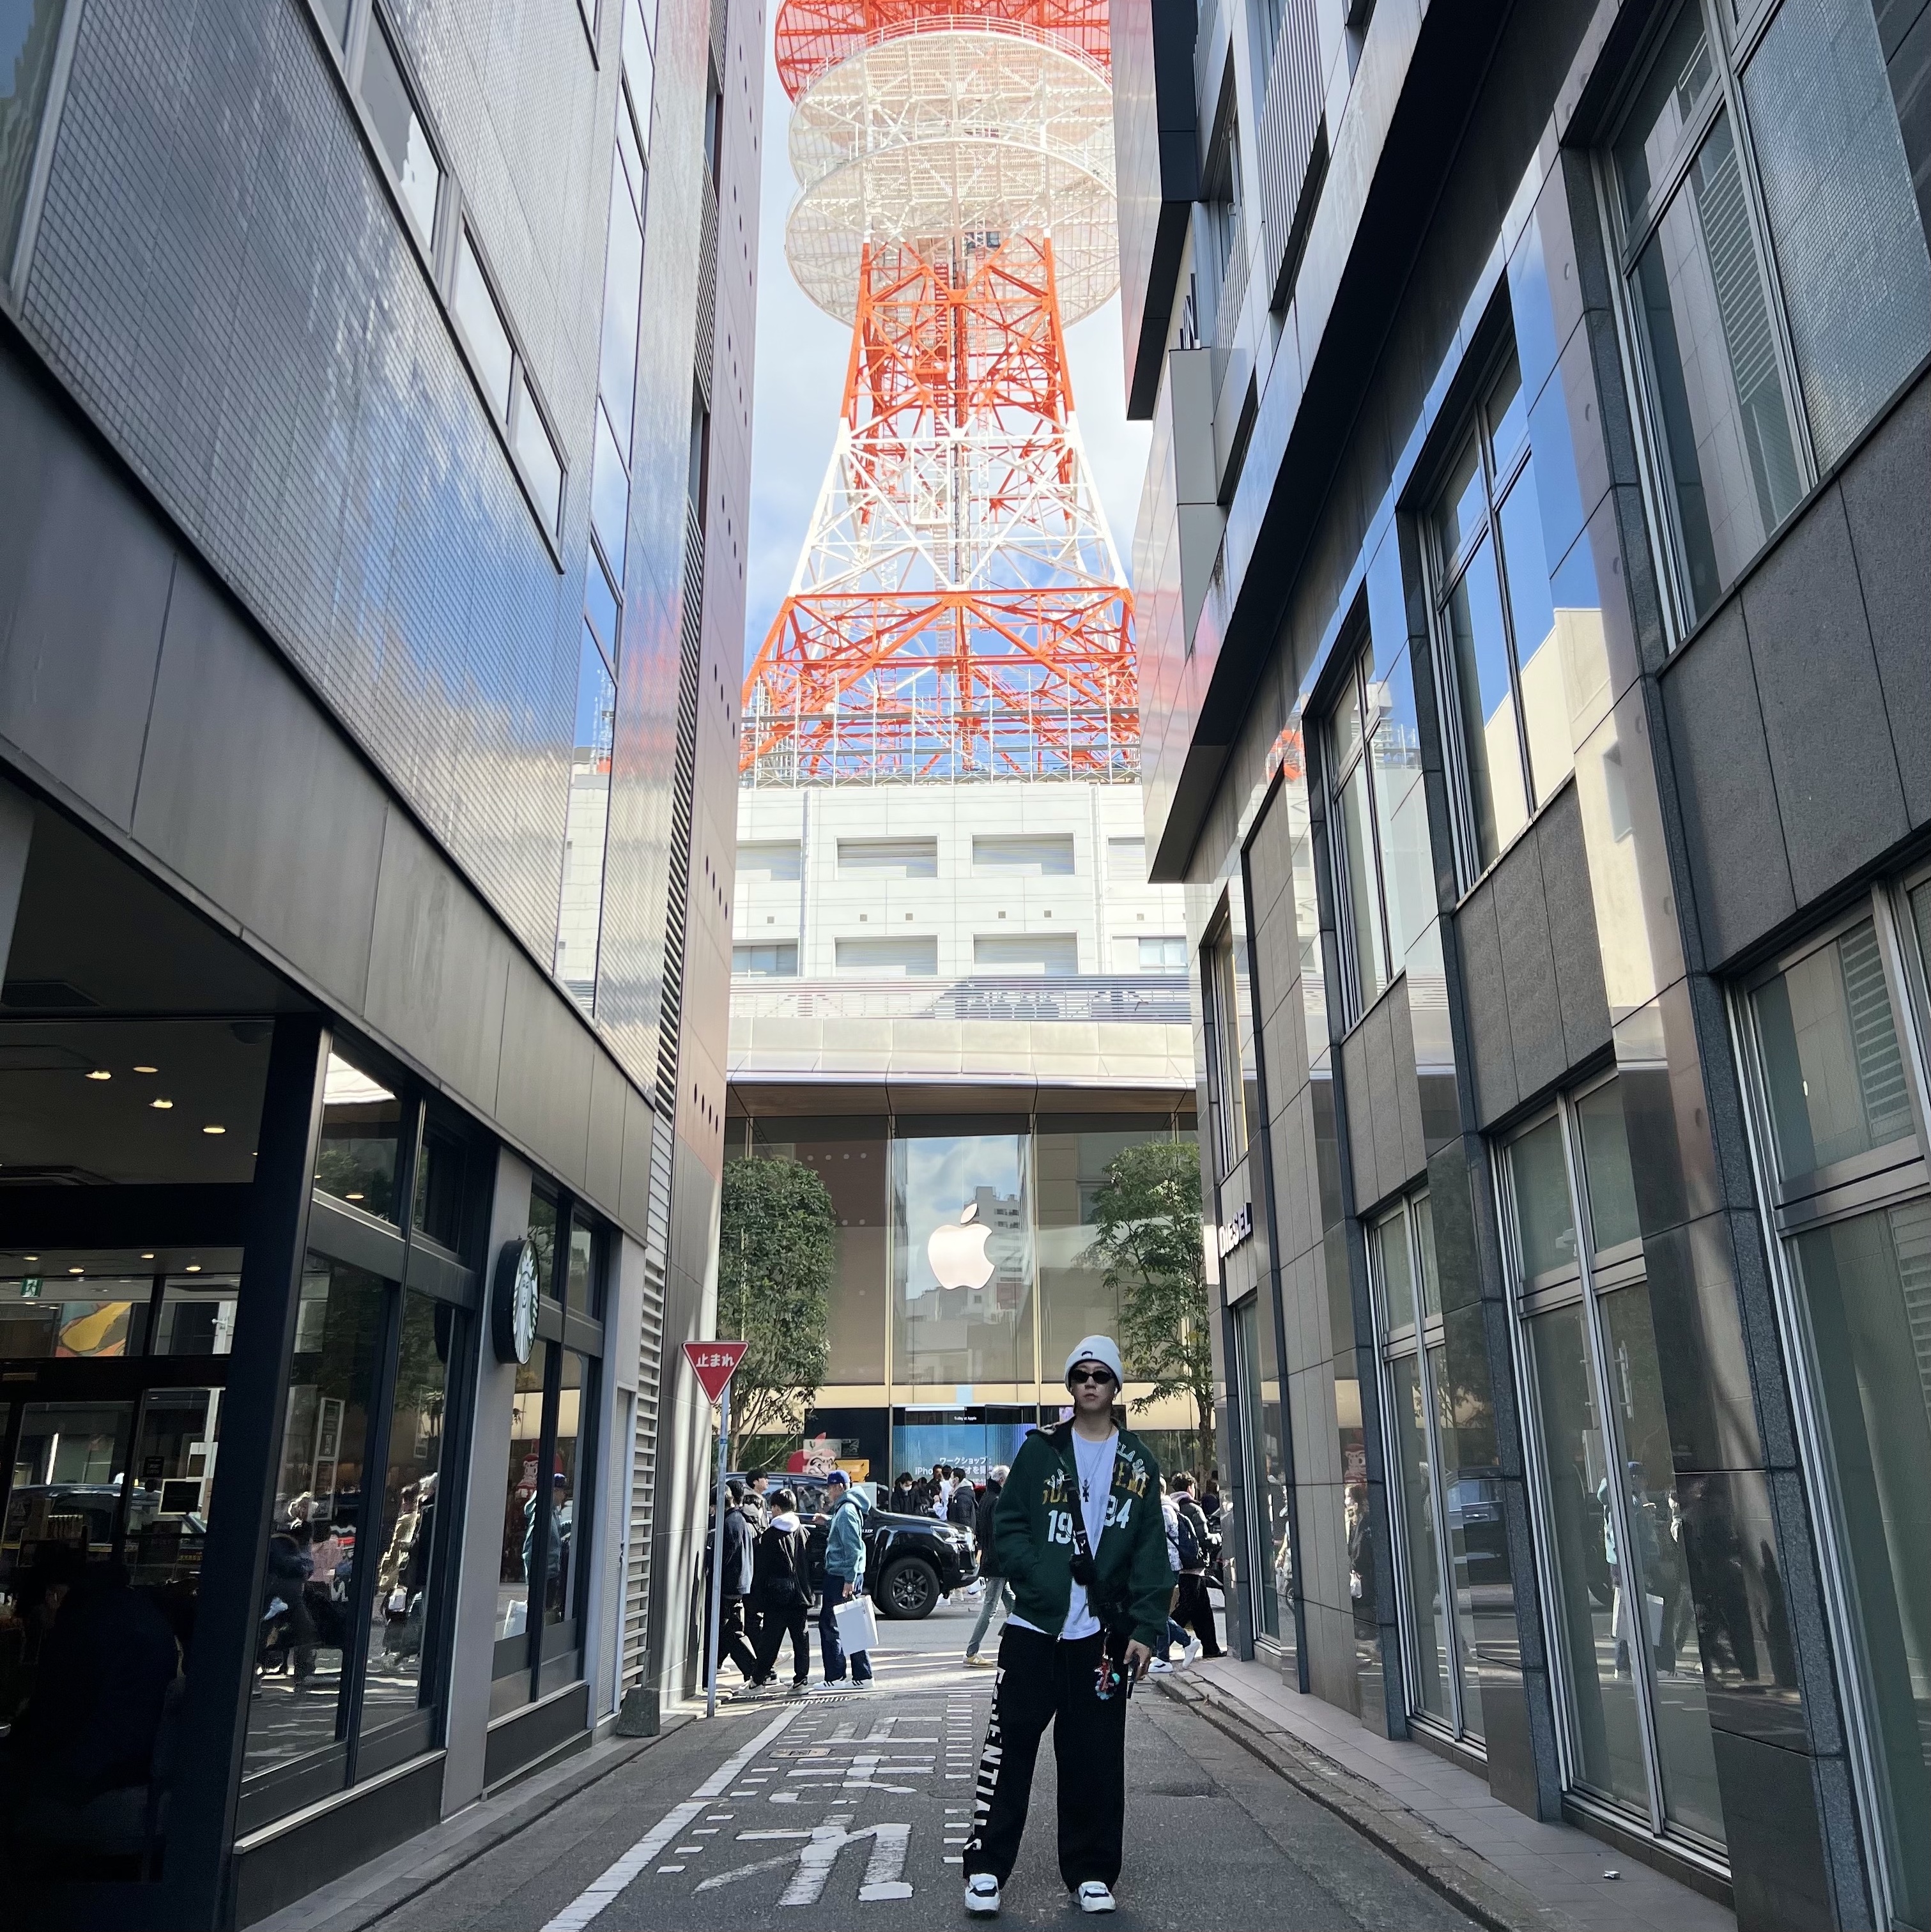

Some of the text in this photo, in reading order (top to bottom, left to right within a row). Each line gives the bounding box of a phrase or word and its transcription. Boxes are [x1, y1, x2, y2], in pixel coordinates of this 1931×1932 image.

[1219, 1202, 1251, 1258] DIESEL
[695, 1353, 734, 1367] 止まれ
[1048, 1509, 1073, 1544] 19
